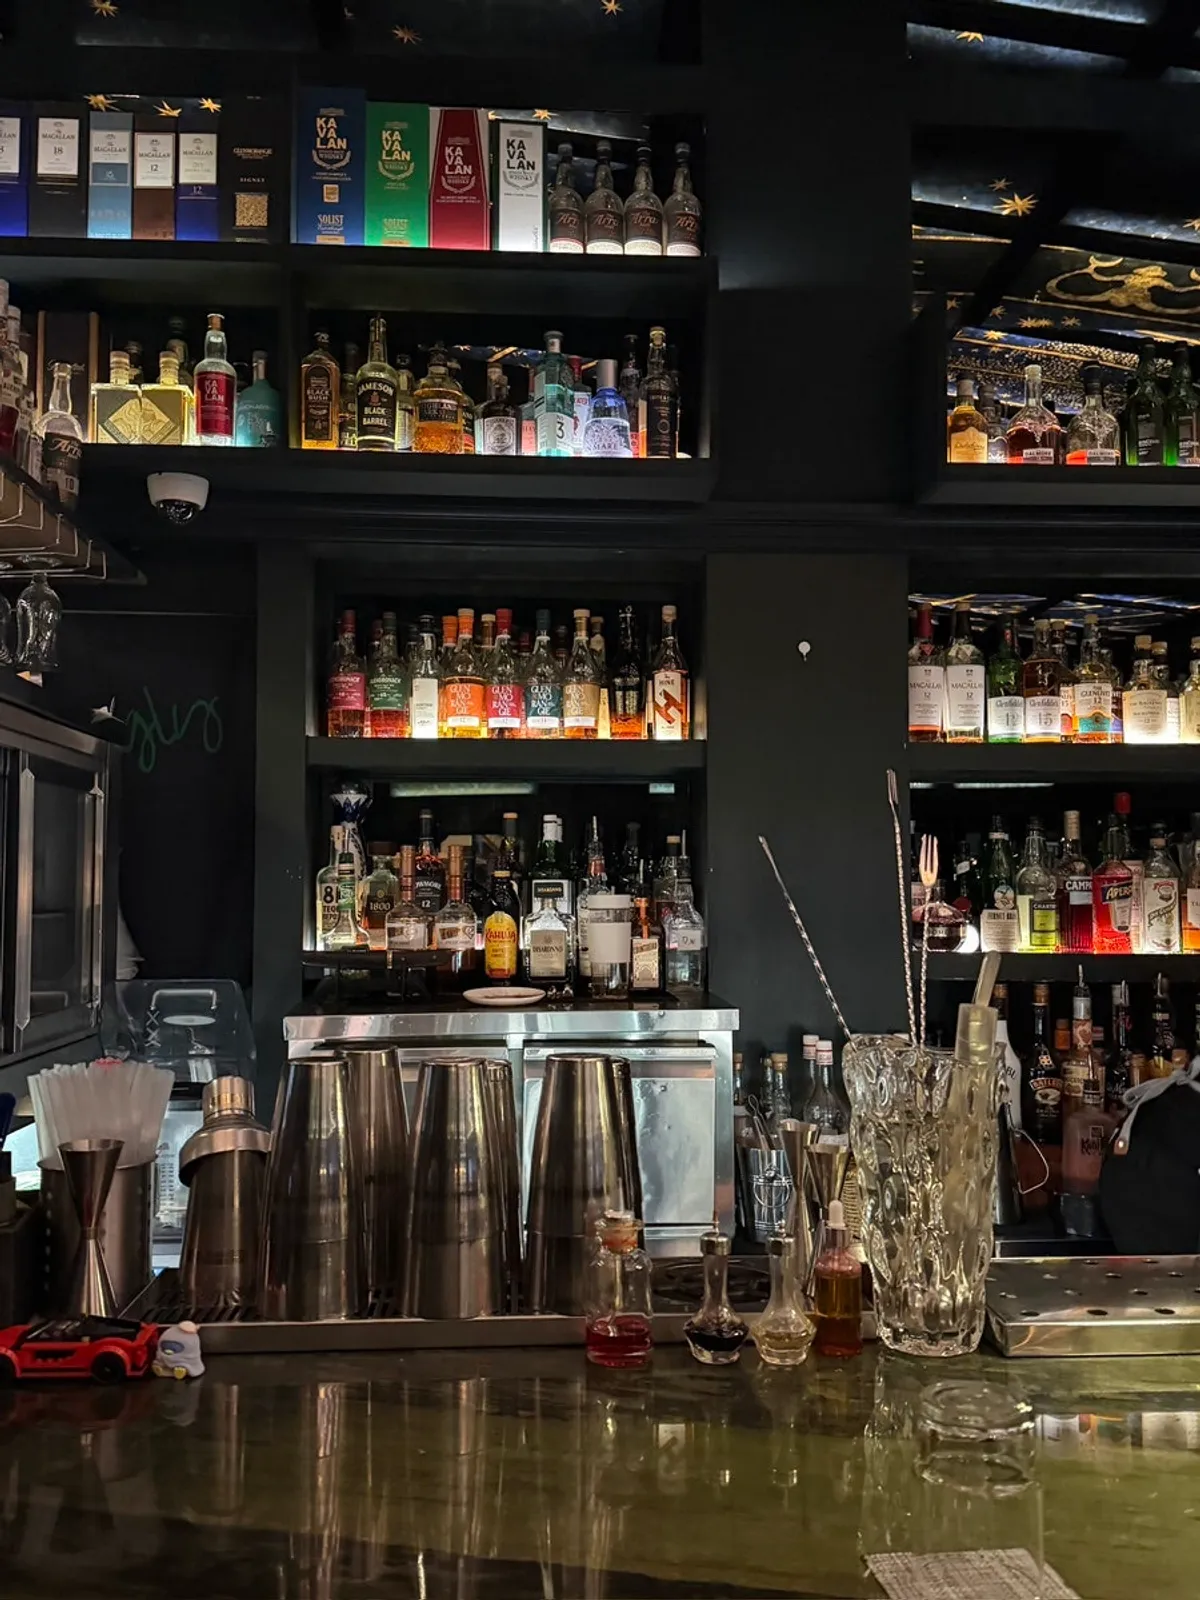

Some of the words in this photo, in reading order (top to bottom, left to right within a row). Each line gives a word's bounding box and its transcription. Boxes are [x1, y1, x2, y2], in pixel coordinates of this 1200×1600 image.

[316, 117, 338, 128] KA
[317, 128, 338, 138] VA
[382, 130, 402, 141] KA
[316, 138, 347, 149] LAN
[383, 141, 402, 151] VA
[506, 139, 527, 150] KA
[382, 151, 411, 161] LAN
[445, 146, 464, 156] KA
[507, 150, 527, 160] VA
[446, 156, 464, 165] VA
[506, 160, 536, 171] LAN
[150, 164, 159, 172] 12
[445, 165, 472, 175] LAN
[193, 186, 202, 194] 12
[317, 214, 344, 226] SOLIST
[358, 382, 394, 396] JAMESON
[364, 407, 386, 415] BLACK
[362, 417, 388, 426] BARREL
[556, 421, 565, 439] 3
[1106, 884, 1132, 900] APERO
[369, 902, 391, 911] 1800
[421, 900, 431, 908] 12
